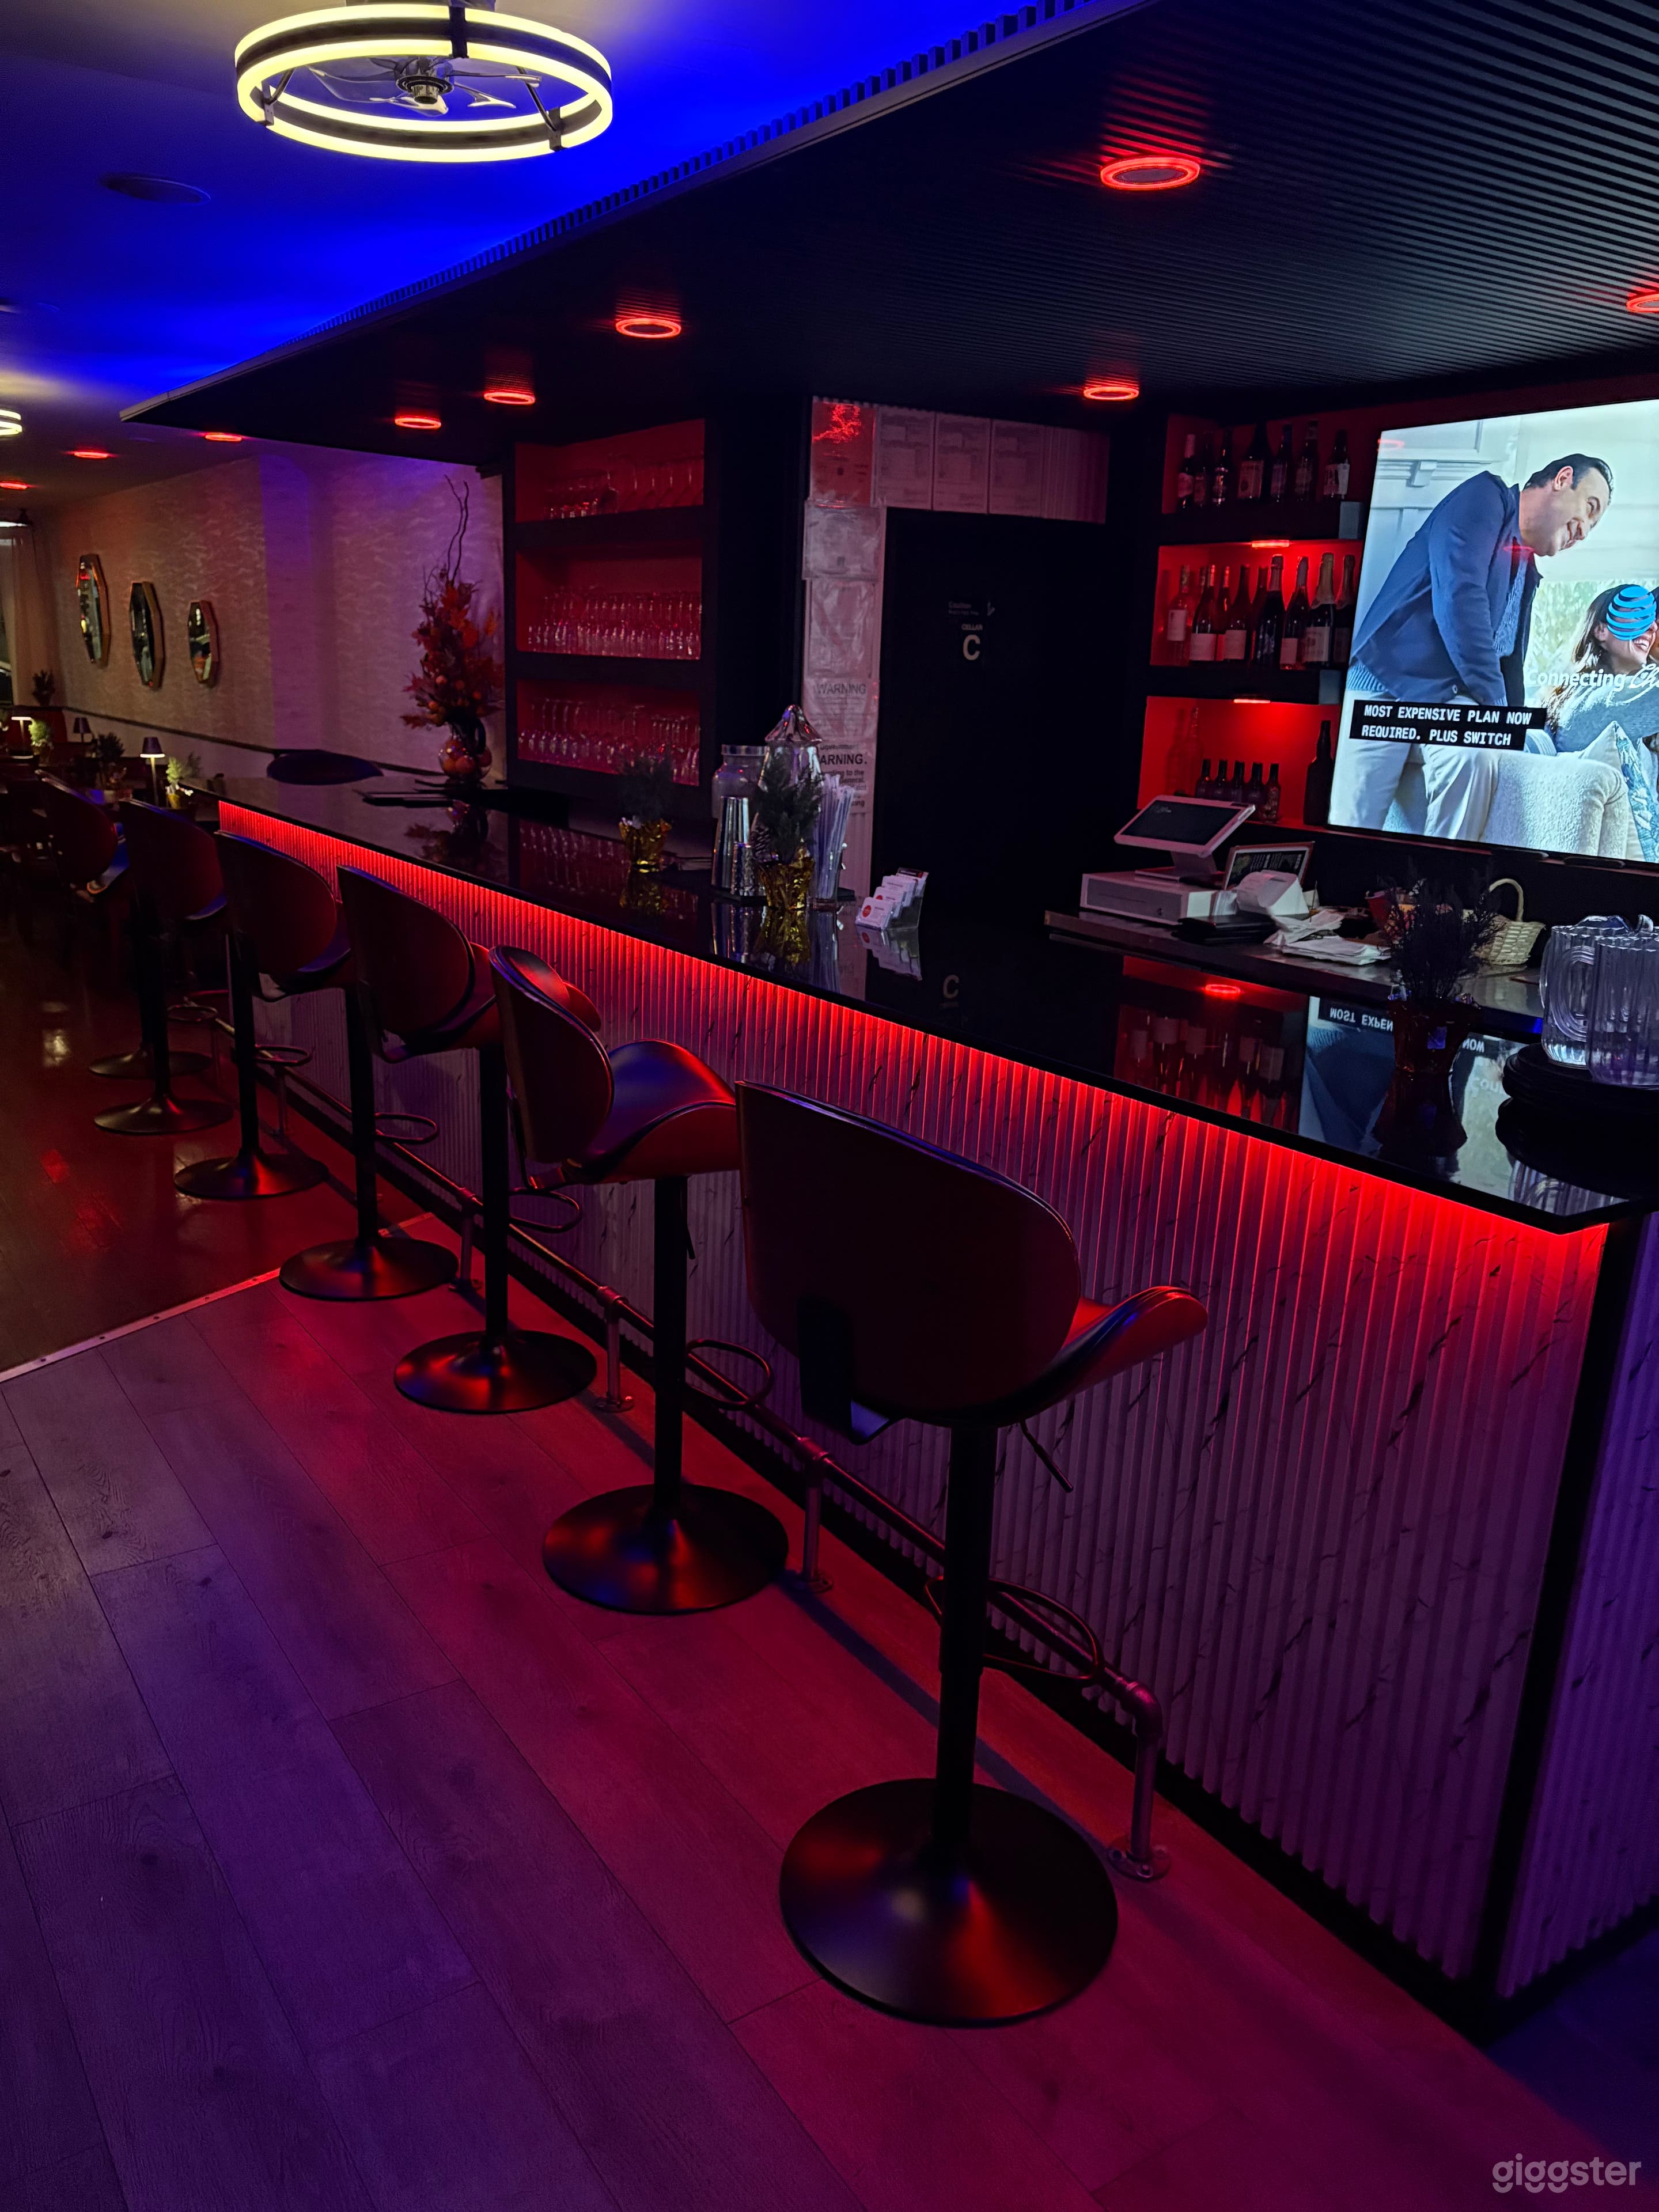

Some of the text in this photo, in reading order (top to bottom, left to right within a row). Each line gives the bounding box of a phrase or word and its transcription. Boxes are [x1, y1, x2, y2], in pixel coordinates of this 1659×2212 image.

[963, 634, 981, 660] C
[816, 683, 866, 695] WARNING
[1528, 668, 1627, 692] Connecting
[1363, 704, 1532, 725] MOST EXPENSIVE PLAN NOW
[1361, 725, 1512, 746] REQUIRED. PLUS SWITCH
[820, 753, 868, 765] ARNING.
